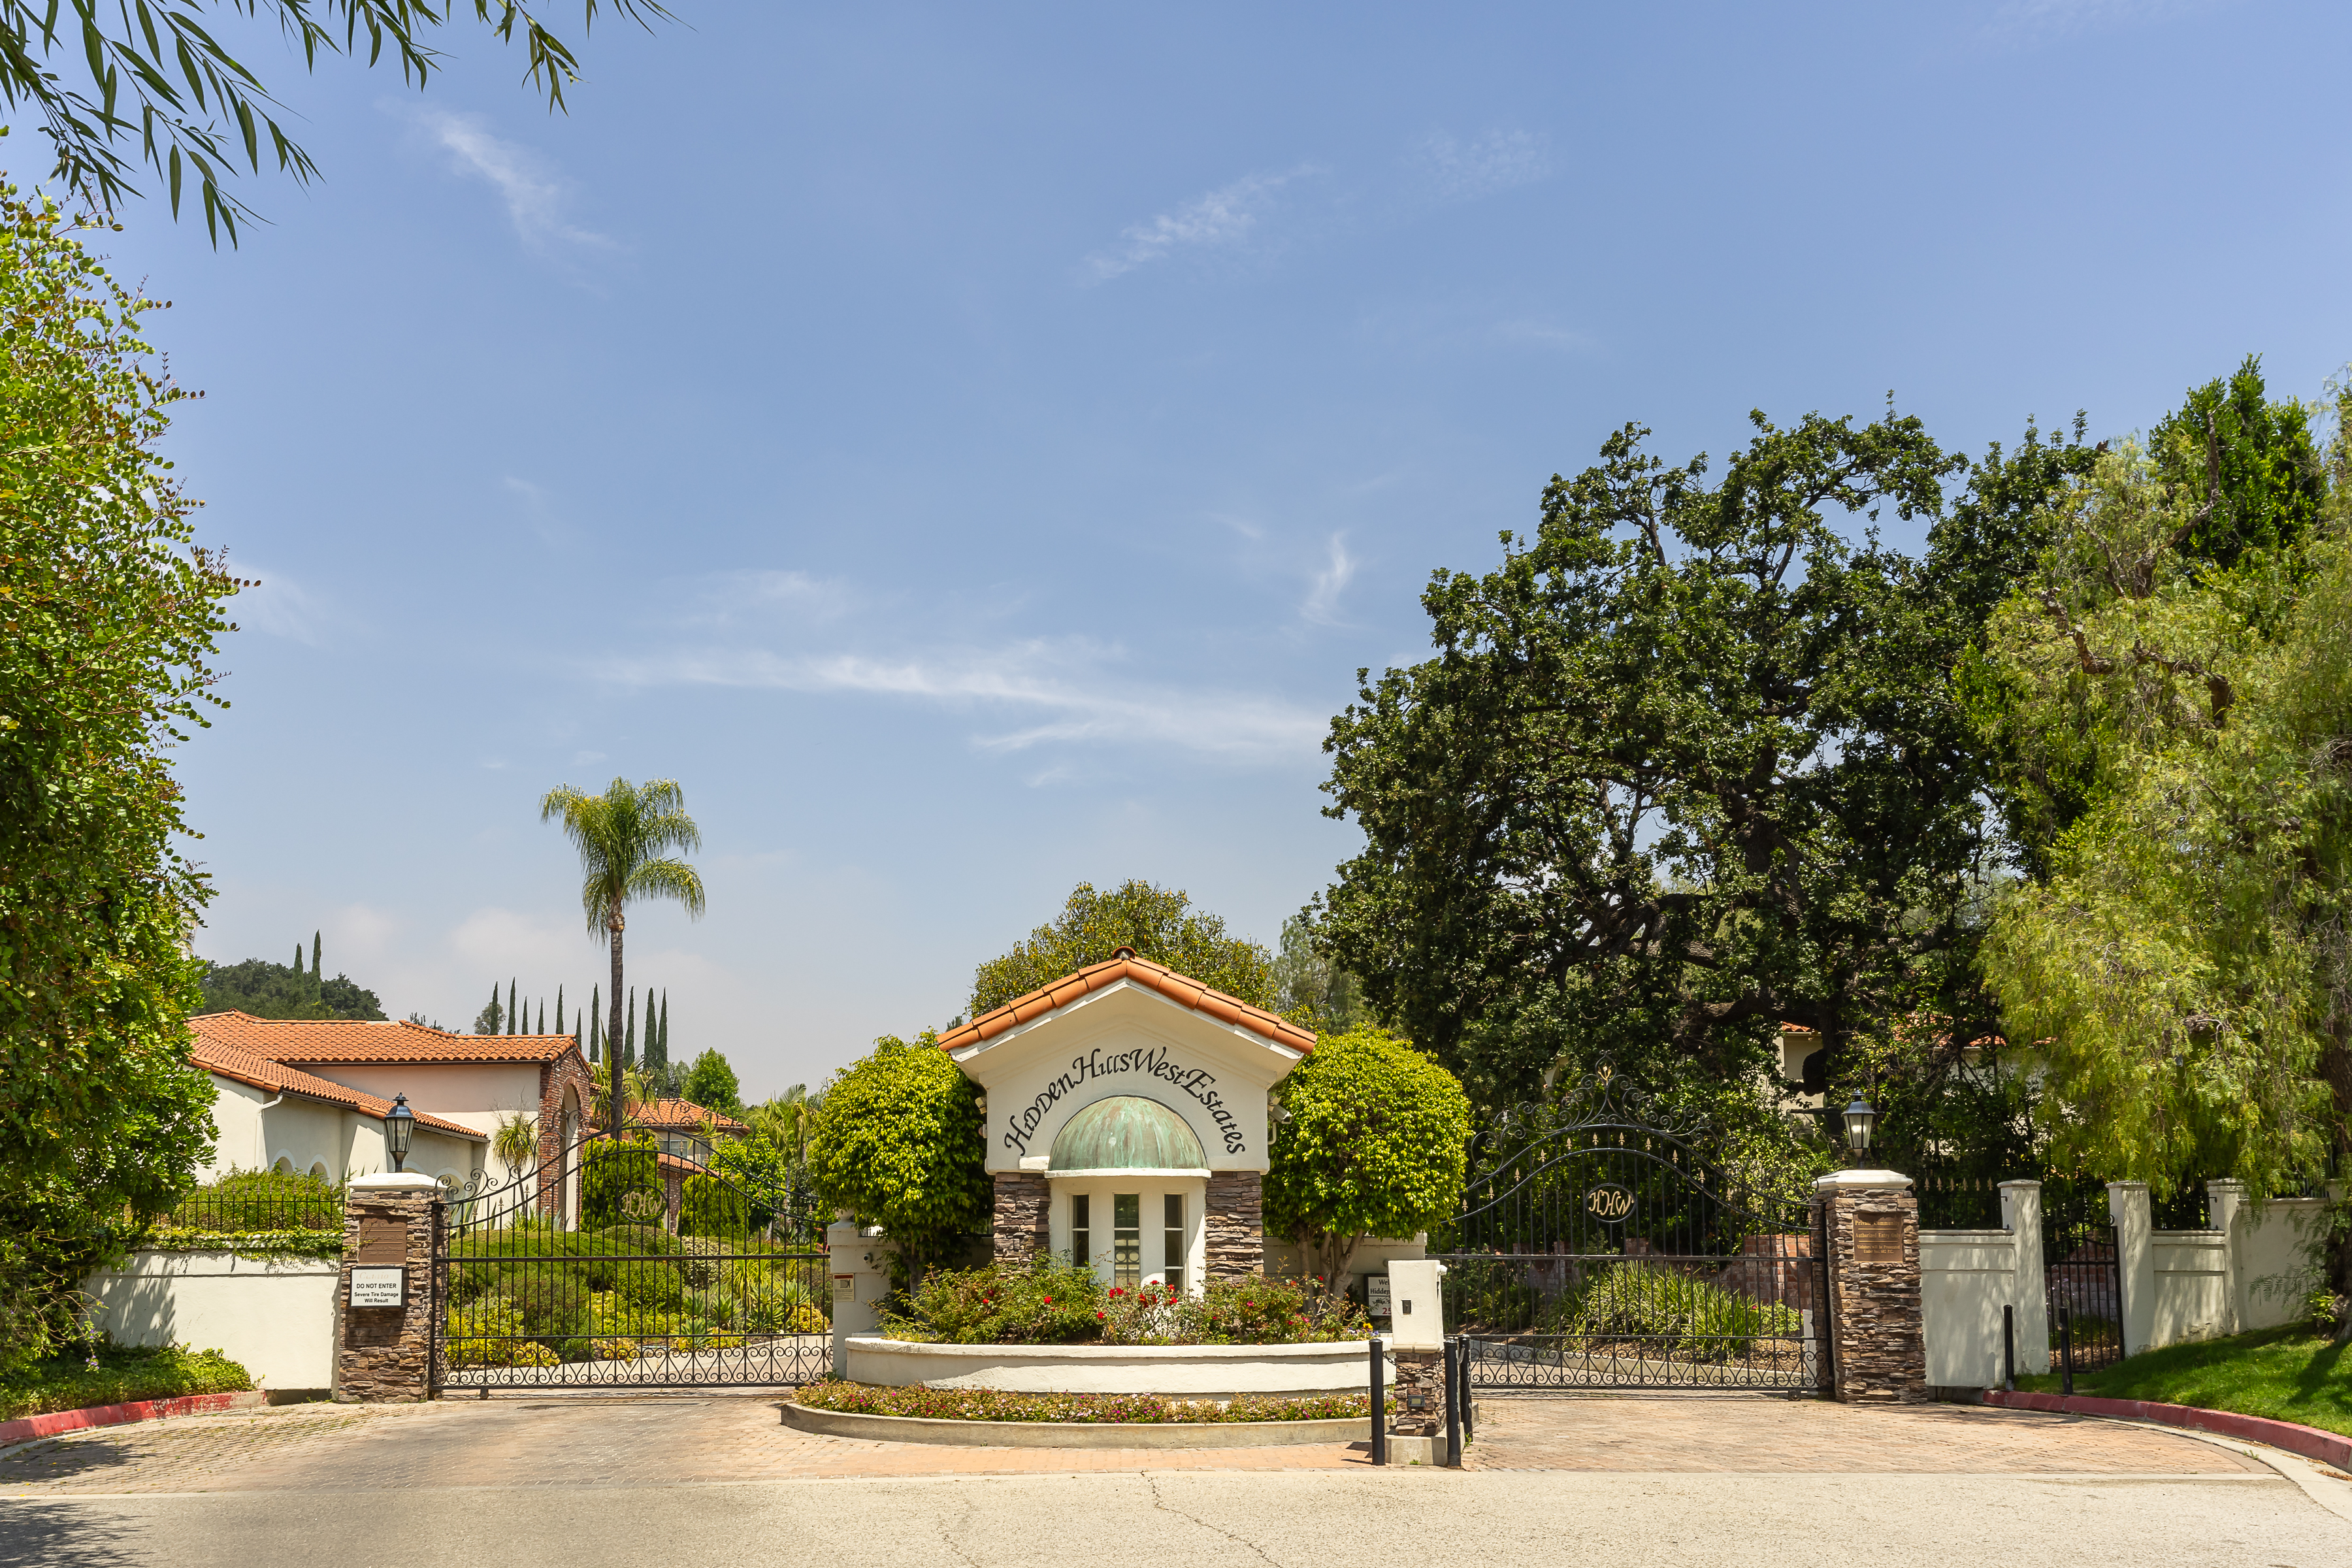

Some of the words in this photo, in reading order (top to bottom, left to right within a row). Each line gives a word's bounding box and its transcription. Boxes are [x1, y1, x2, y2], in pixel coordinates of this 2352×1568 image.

[1072, 1048, 1130, 1085] Hills
[1129, 1046, 1186, 1085] West
[1180, 1069, 1246, 1154] Estates
